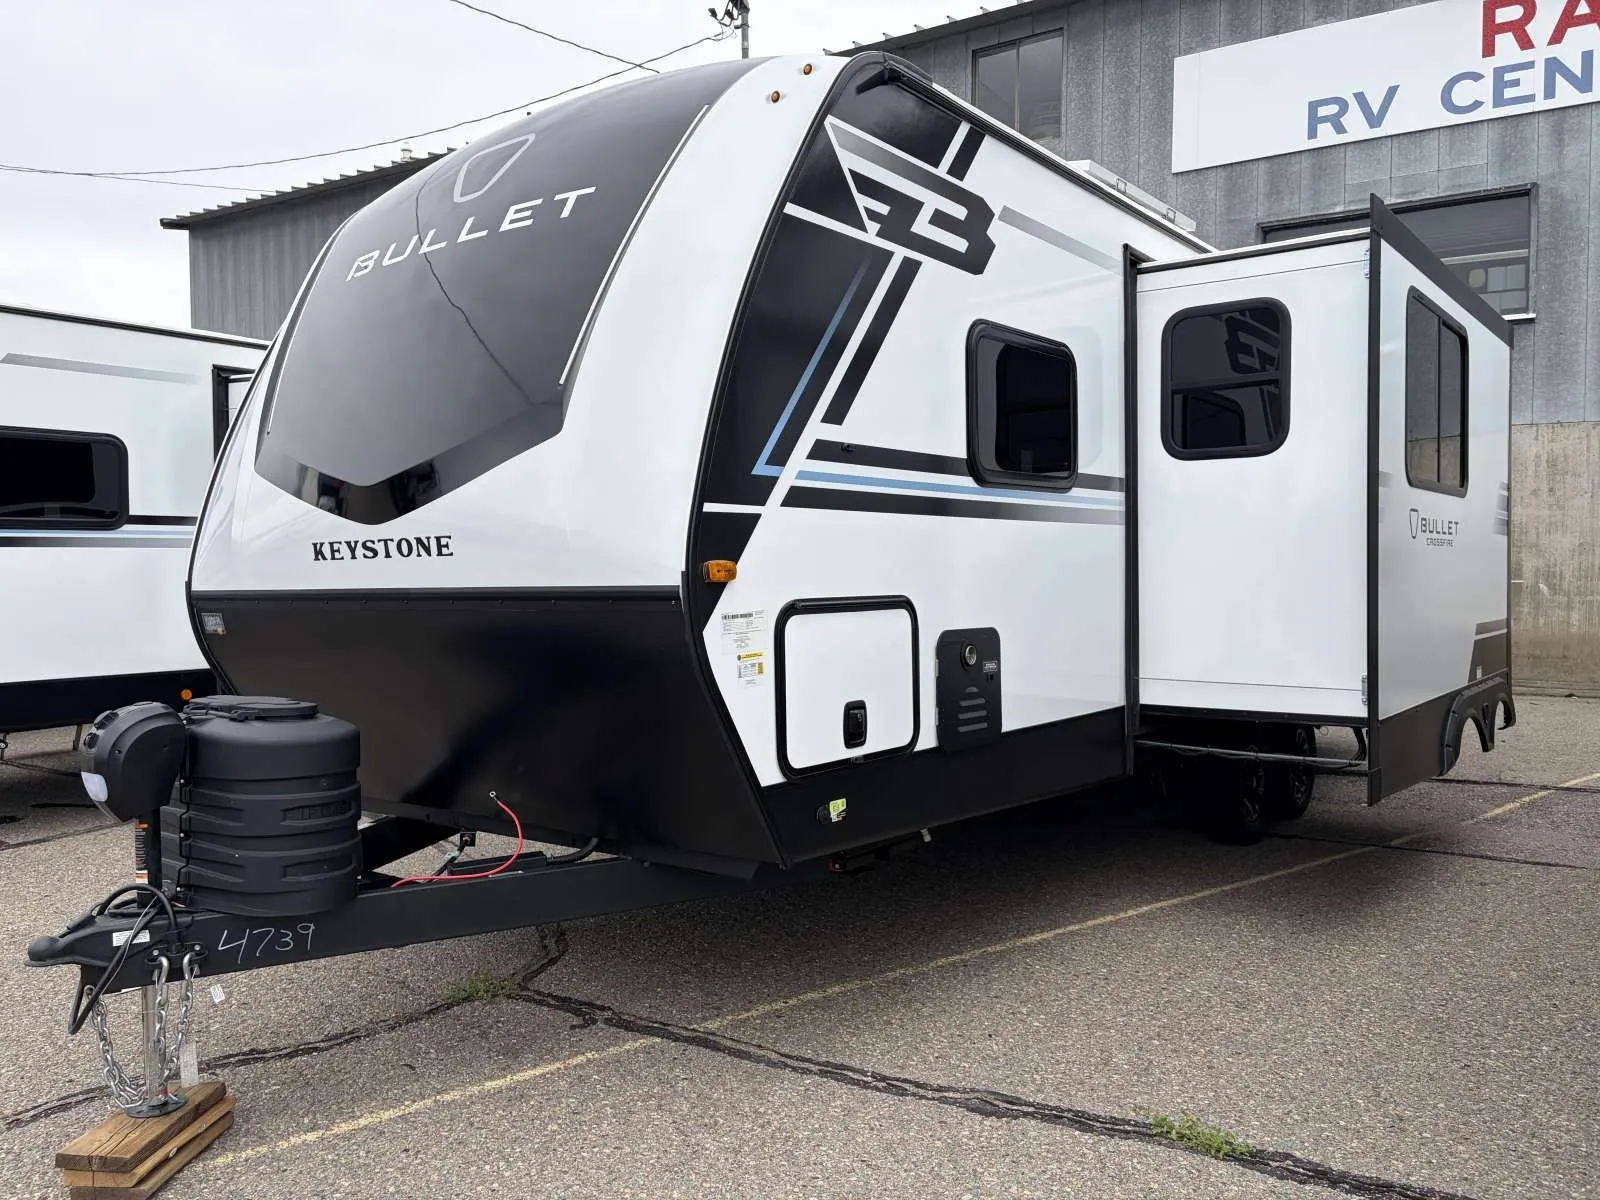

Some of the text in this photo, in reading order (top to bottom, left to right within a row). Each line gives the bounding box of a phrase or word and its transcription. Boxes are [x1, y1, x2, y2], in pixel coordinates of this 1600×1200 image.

[1482, 0, 1600, 58] RA
[1307, 49, 1593, 140] RV CEN
[345, 186, 597, 282] BULLET
[311, 535, 455, 562] KEYSTONE
[1420, 517, 1459, 536] BULLET
[217, 922, 317, 965] 4739
